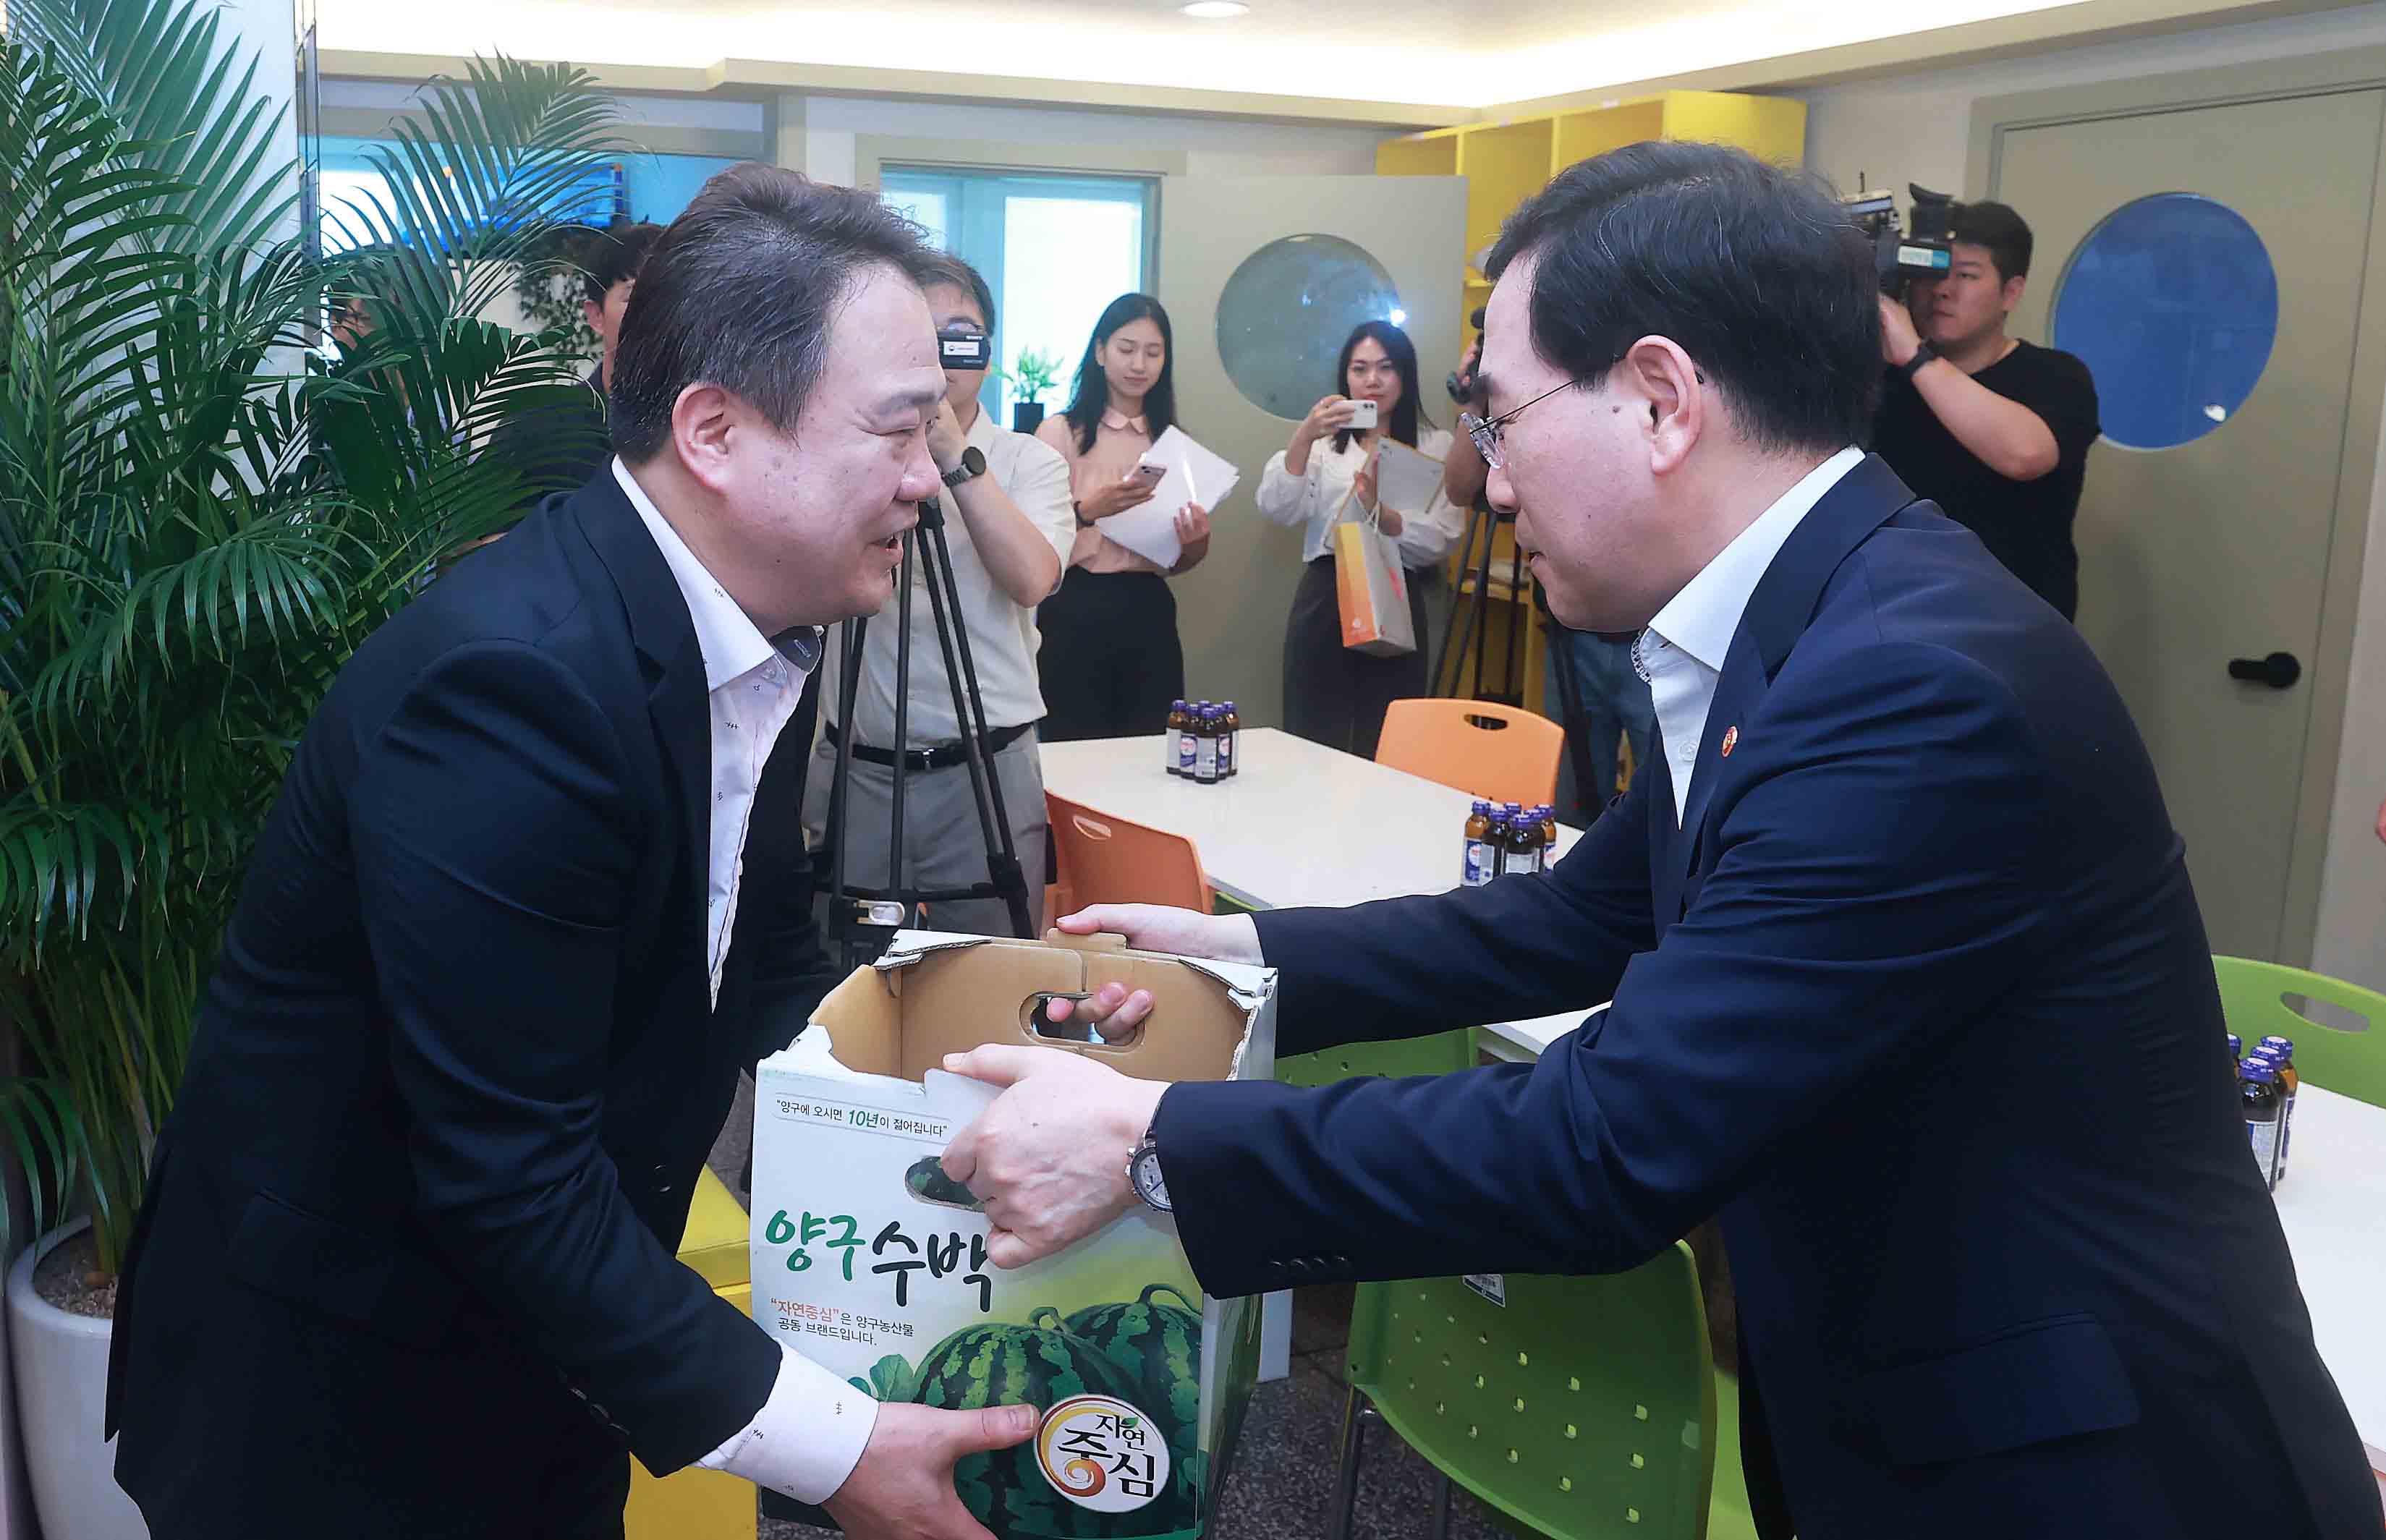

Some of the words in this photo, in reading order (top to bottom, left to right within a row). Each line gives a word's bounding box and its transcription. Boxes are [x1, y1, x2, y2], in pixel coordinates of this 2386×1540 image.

[813, 1106, 843, 1121] 오시면
[848, 1110, 889, 1128] 10년이
[765, 1209, 866, 1281] 양구
[778, 1317, 801, 1332] 공동
[805, 1322, 878, 1345] 브랜드입니다.
[857, 1316, 914, 1337] 양구농산물
[1095, 1414, 1145, 1451] 자연
[1057, 1428, 1155, 1498] 중심
